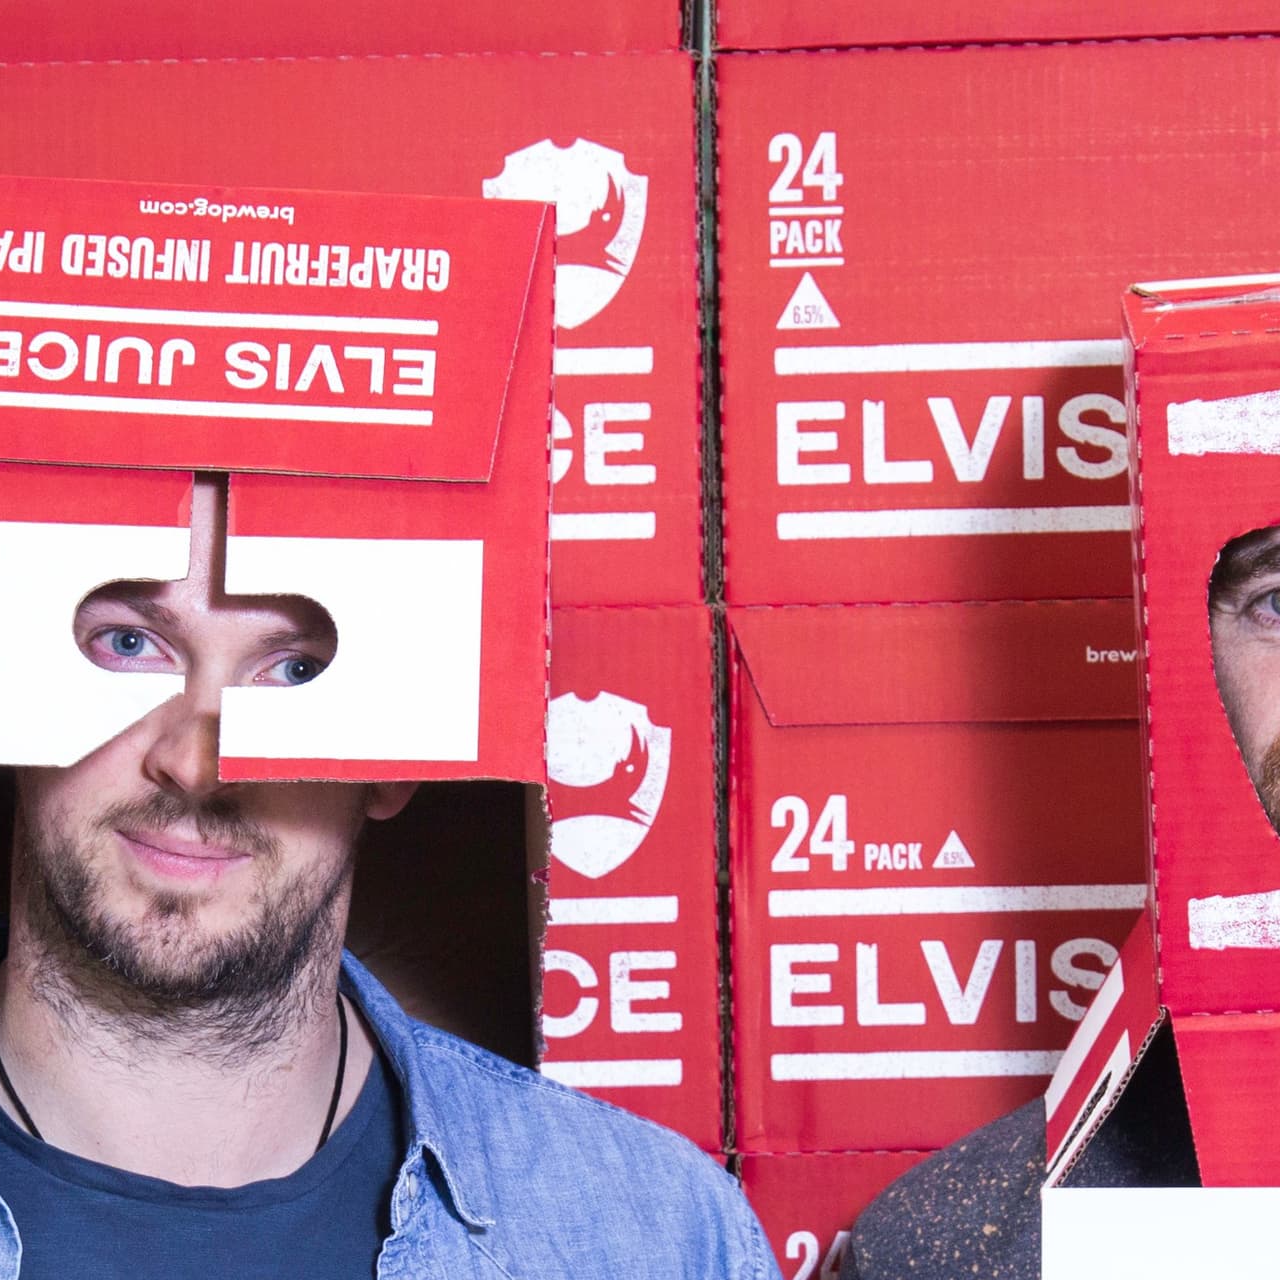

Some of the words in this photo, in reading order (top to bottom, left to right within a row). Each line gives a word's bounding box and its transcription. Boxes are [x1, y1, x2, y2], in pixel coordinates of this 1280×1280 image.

[769, 133, 843, 202] 24
[140, 198, 294, 225] brewdog.com
[771, 220, 842, 254] PACK
[62, 235, 210, 282] INFUSED
[225, 242, 450, 291] GRAPEFRUIT
[792, 304, 824, 325] 6.5%
[226, 342, 436, 396] ELVIS
[776, 395, 1130, 485] ELVIS
[771, 795, 854, 872] 24
[865, 843, 922, 870] PACK
[770, 939, 1119, 1026] ELVIS
